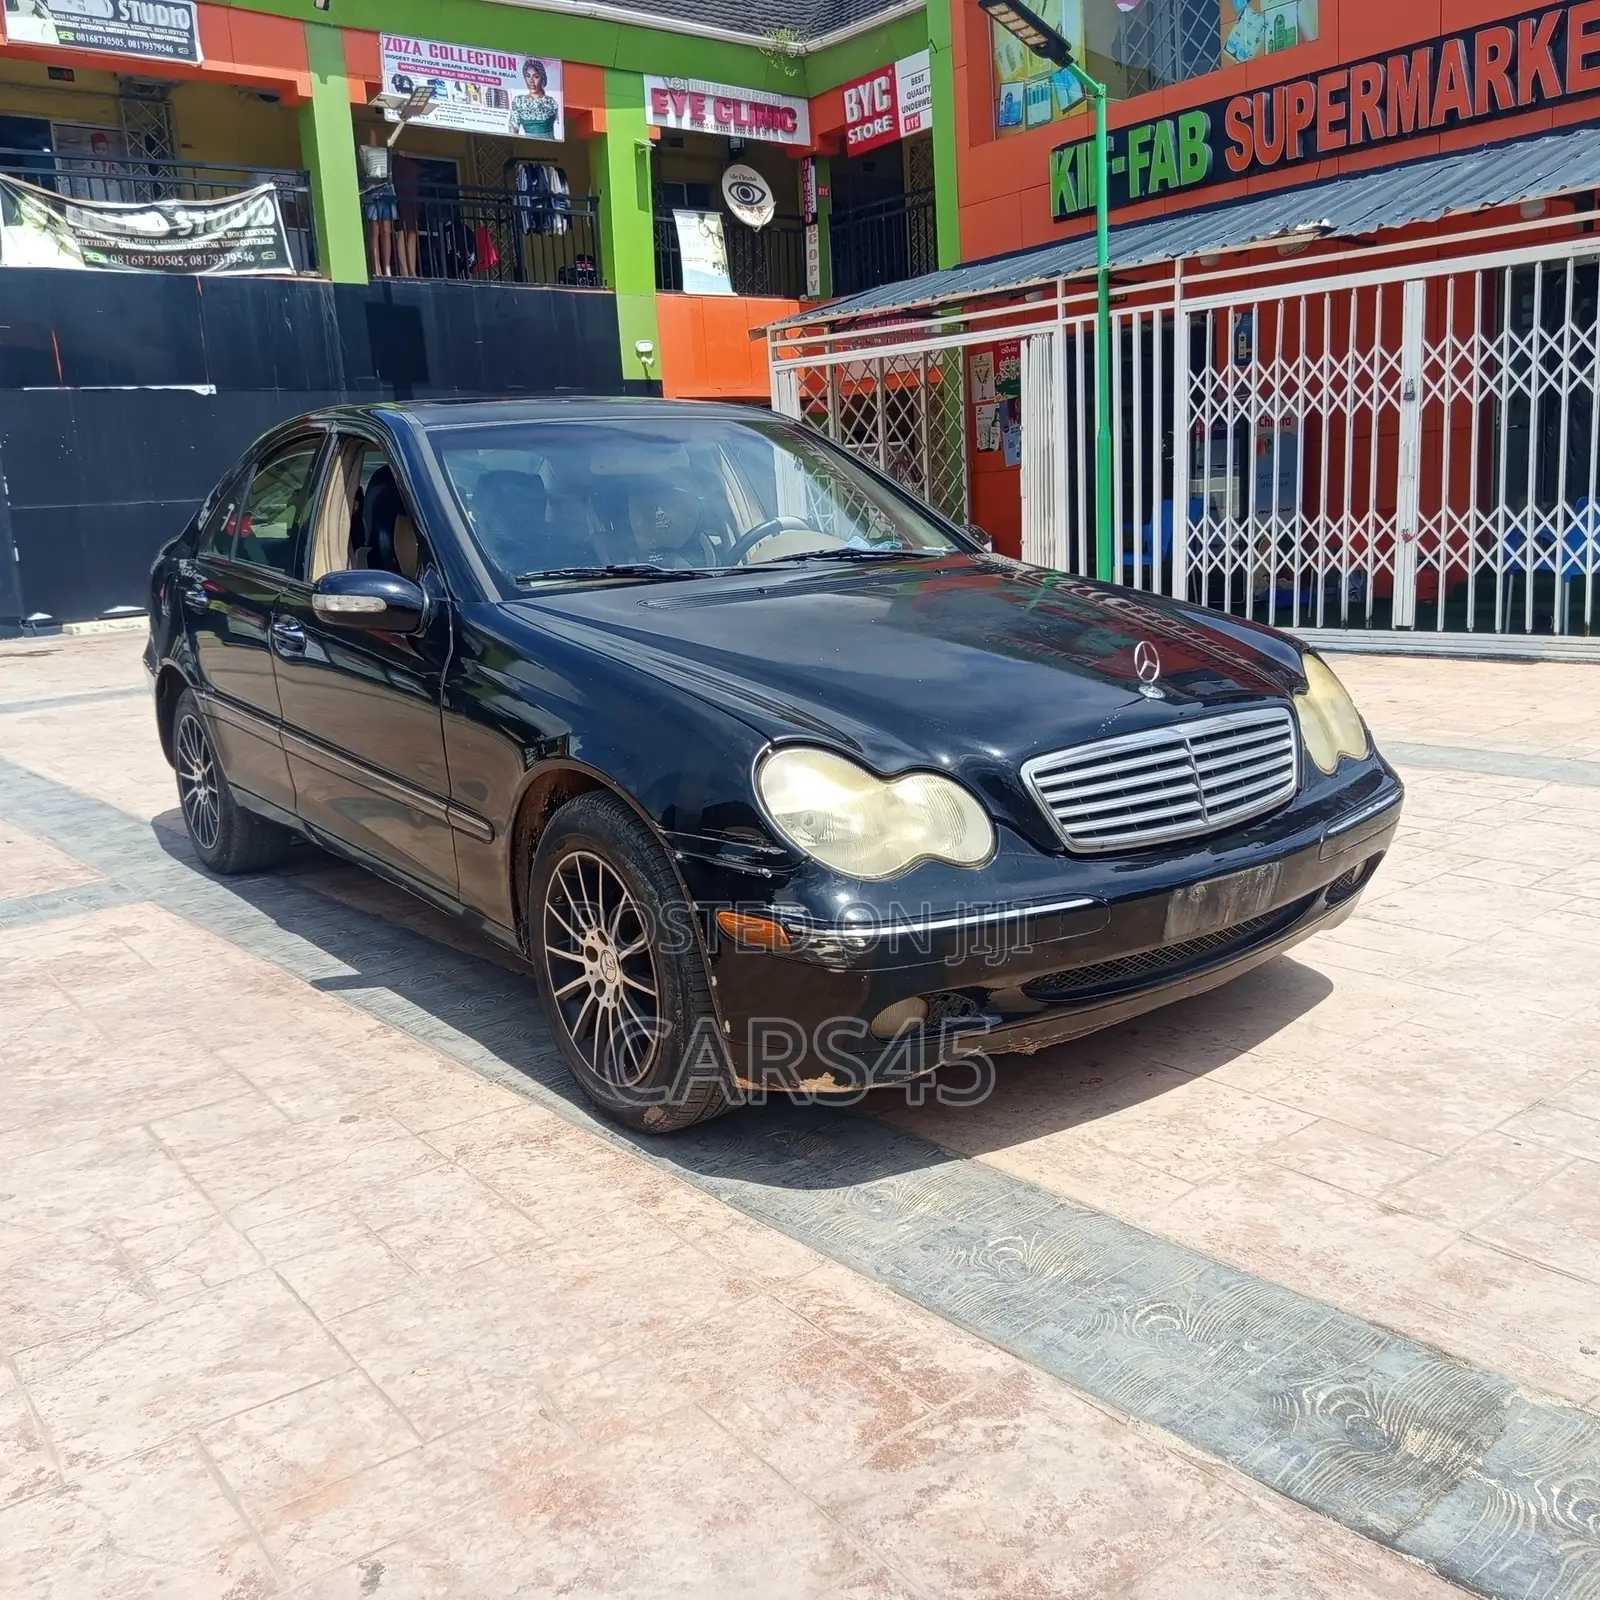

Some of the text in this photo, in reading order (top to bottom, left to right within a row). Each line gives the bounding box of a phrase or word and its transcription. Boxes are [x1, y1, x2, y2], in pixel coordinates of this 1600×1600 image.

[118, 0, 190, 29] STUDIO
[76, 32, 174, 54] 08168730505, 08179379546
[383, 36, 517, 71] ZOZA COLLECTION
[411, 57, 440, 67] BOUTIQUE
[441, 62, 462, 70] WEARS
[463, 65, 490, 75] SUPPLIER
[498, 71, 517, 79] ABUJA
[910, 74, 925, 86] BEST
[906, 84, 931, 100] QUALITY
[1225, 0, 1600, 172] SUPERMARKE
[651, 88, 706, 121] EYE
[713, 96, 799, 132] CLINIC
[844, 76, 891, 123] BYC
[847, 115, 893, 144] STORE
[905, 119, 920, 130] BYC
[110, 250, 255, 267] 08168730505, 08179379546
